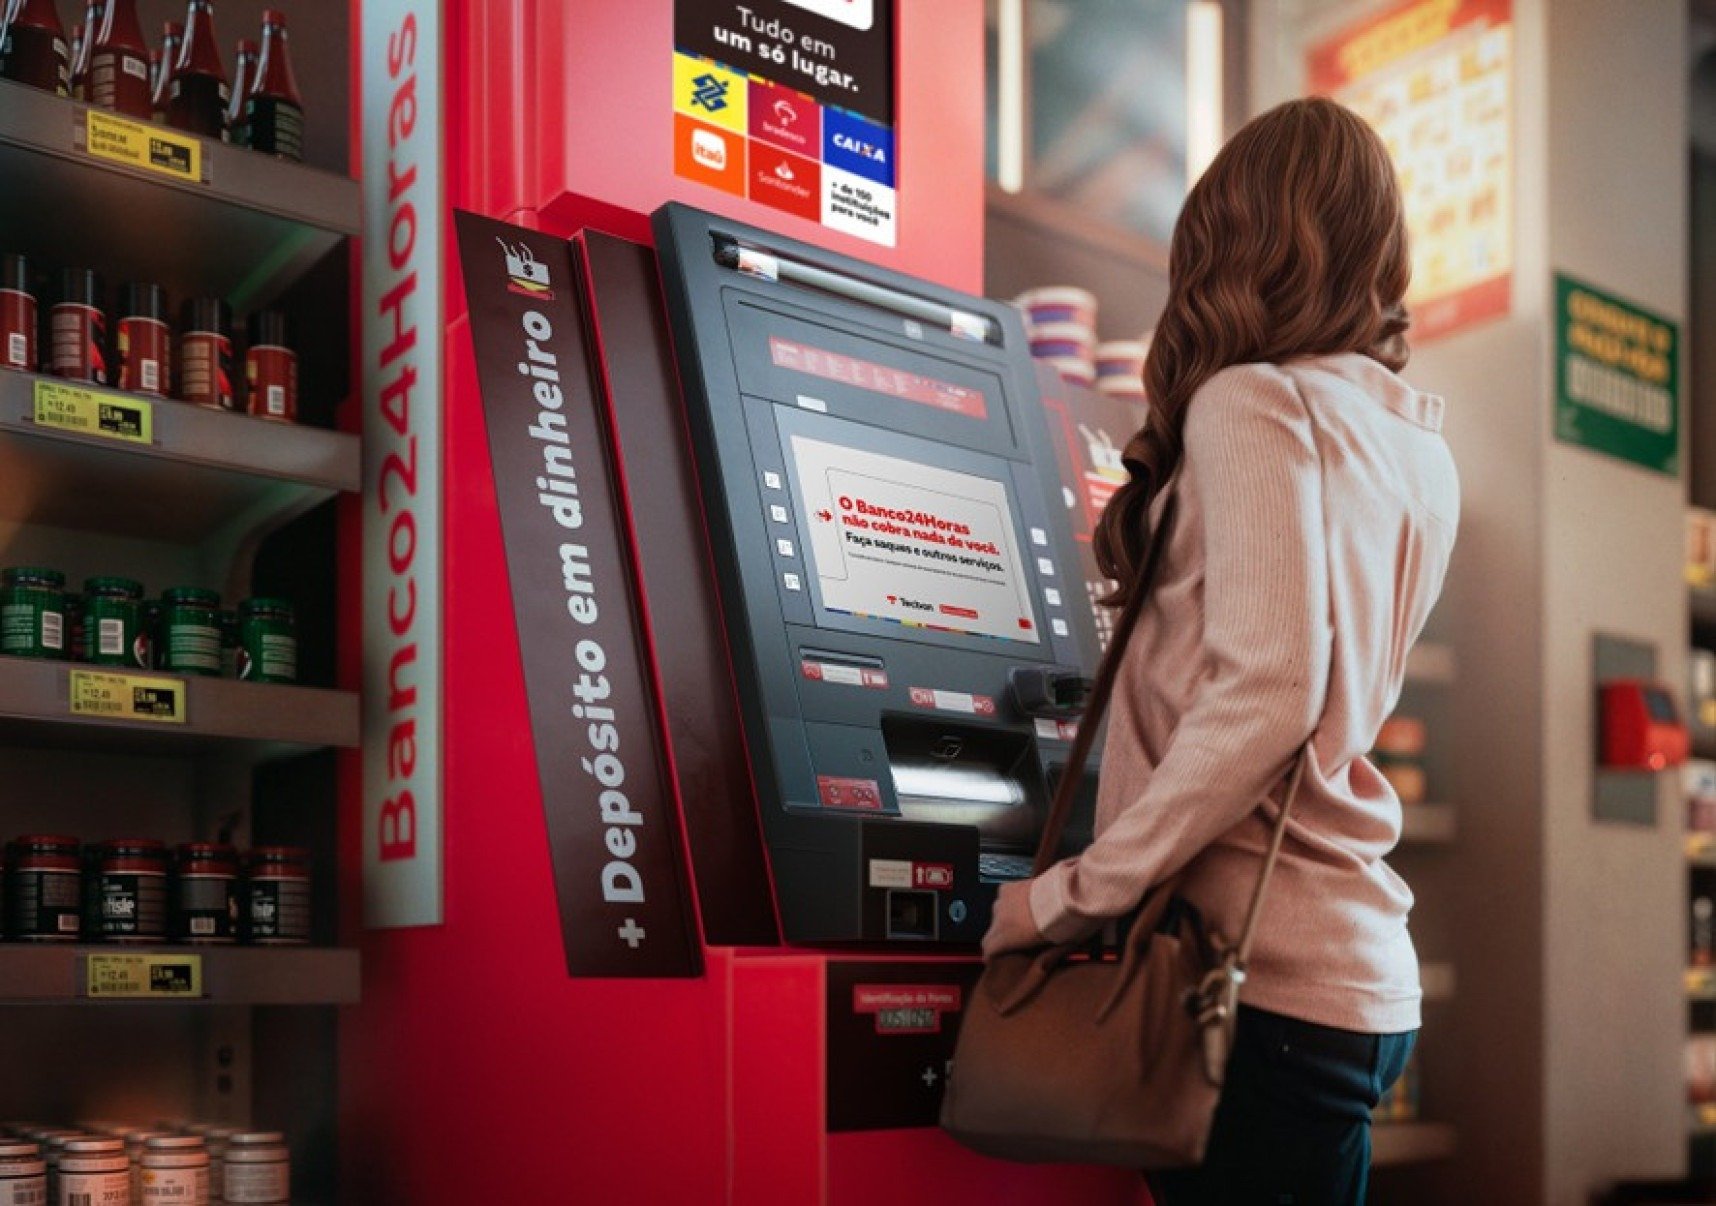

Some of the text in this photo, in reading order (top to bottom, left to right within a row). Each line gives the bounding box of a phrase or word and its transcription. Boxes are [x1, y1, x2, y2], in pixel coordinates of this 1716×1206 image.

[713, 25, 859, 92] um só lugar.
[736, 5, 836, 60] Tudo em
[832, 133, 886, 163] CAIXA
[379, 12, 417, 863] Banco24Horas
[518, 310, 583, 530] dinheiro
[838, 496, 971, 535] O Banco24Horas
[842, 515, 868, 529] não
[871, 520, 911, 537] cobra
[913, 529, 946, 545] nada
[948, 534, 963, 548] de
[845, 531, 873, 547] Faça
[874, 539, 912, 554] saques
[914, 547, 921, 556] e
[922, 549, 958, 563] outros
[558, 542, 600, 625] em
[572, 640, 646, 903] Depósito
